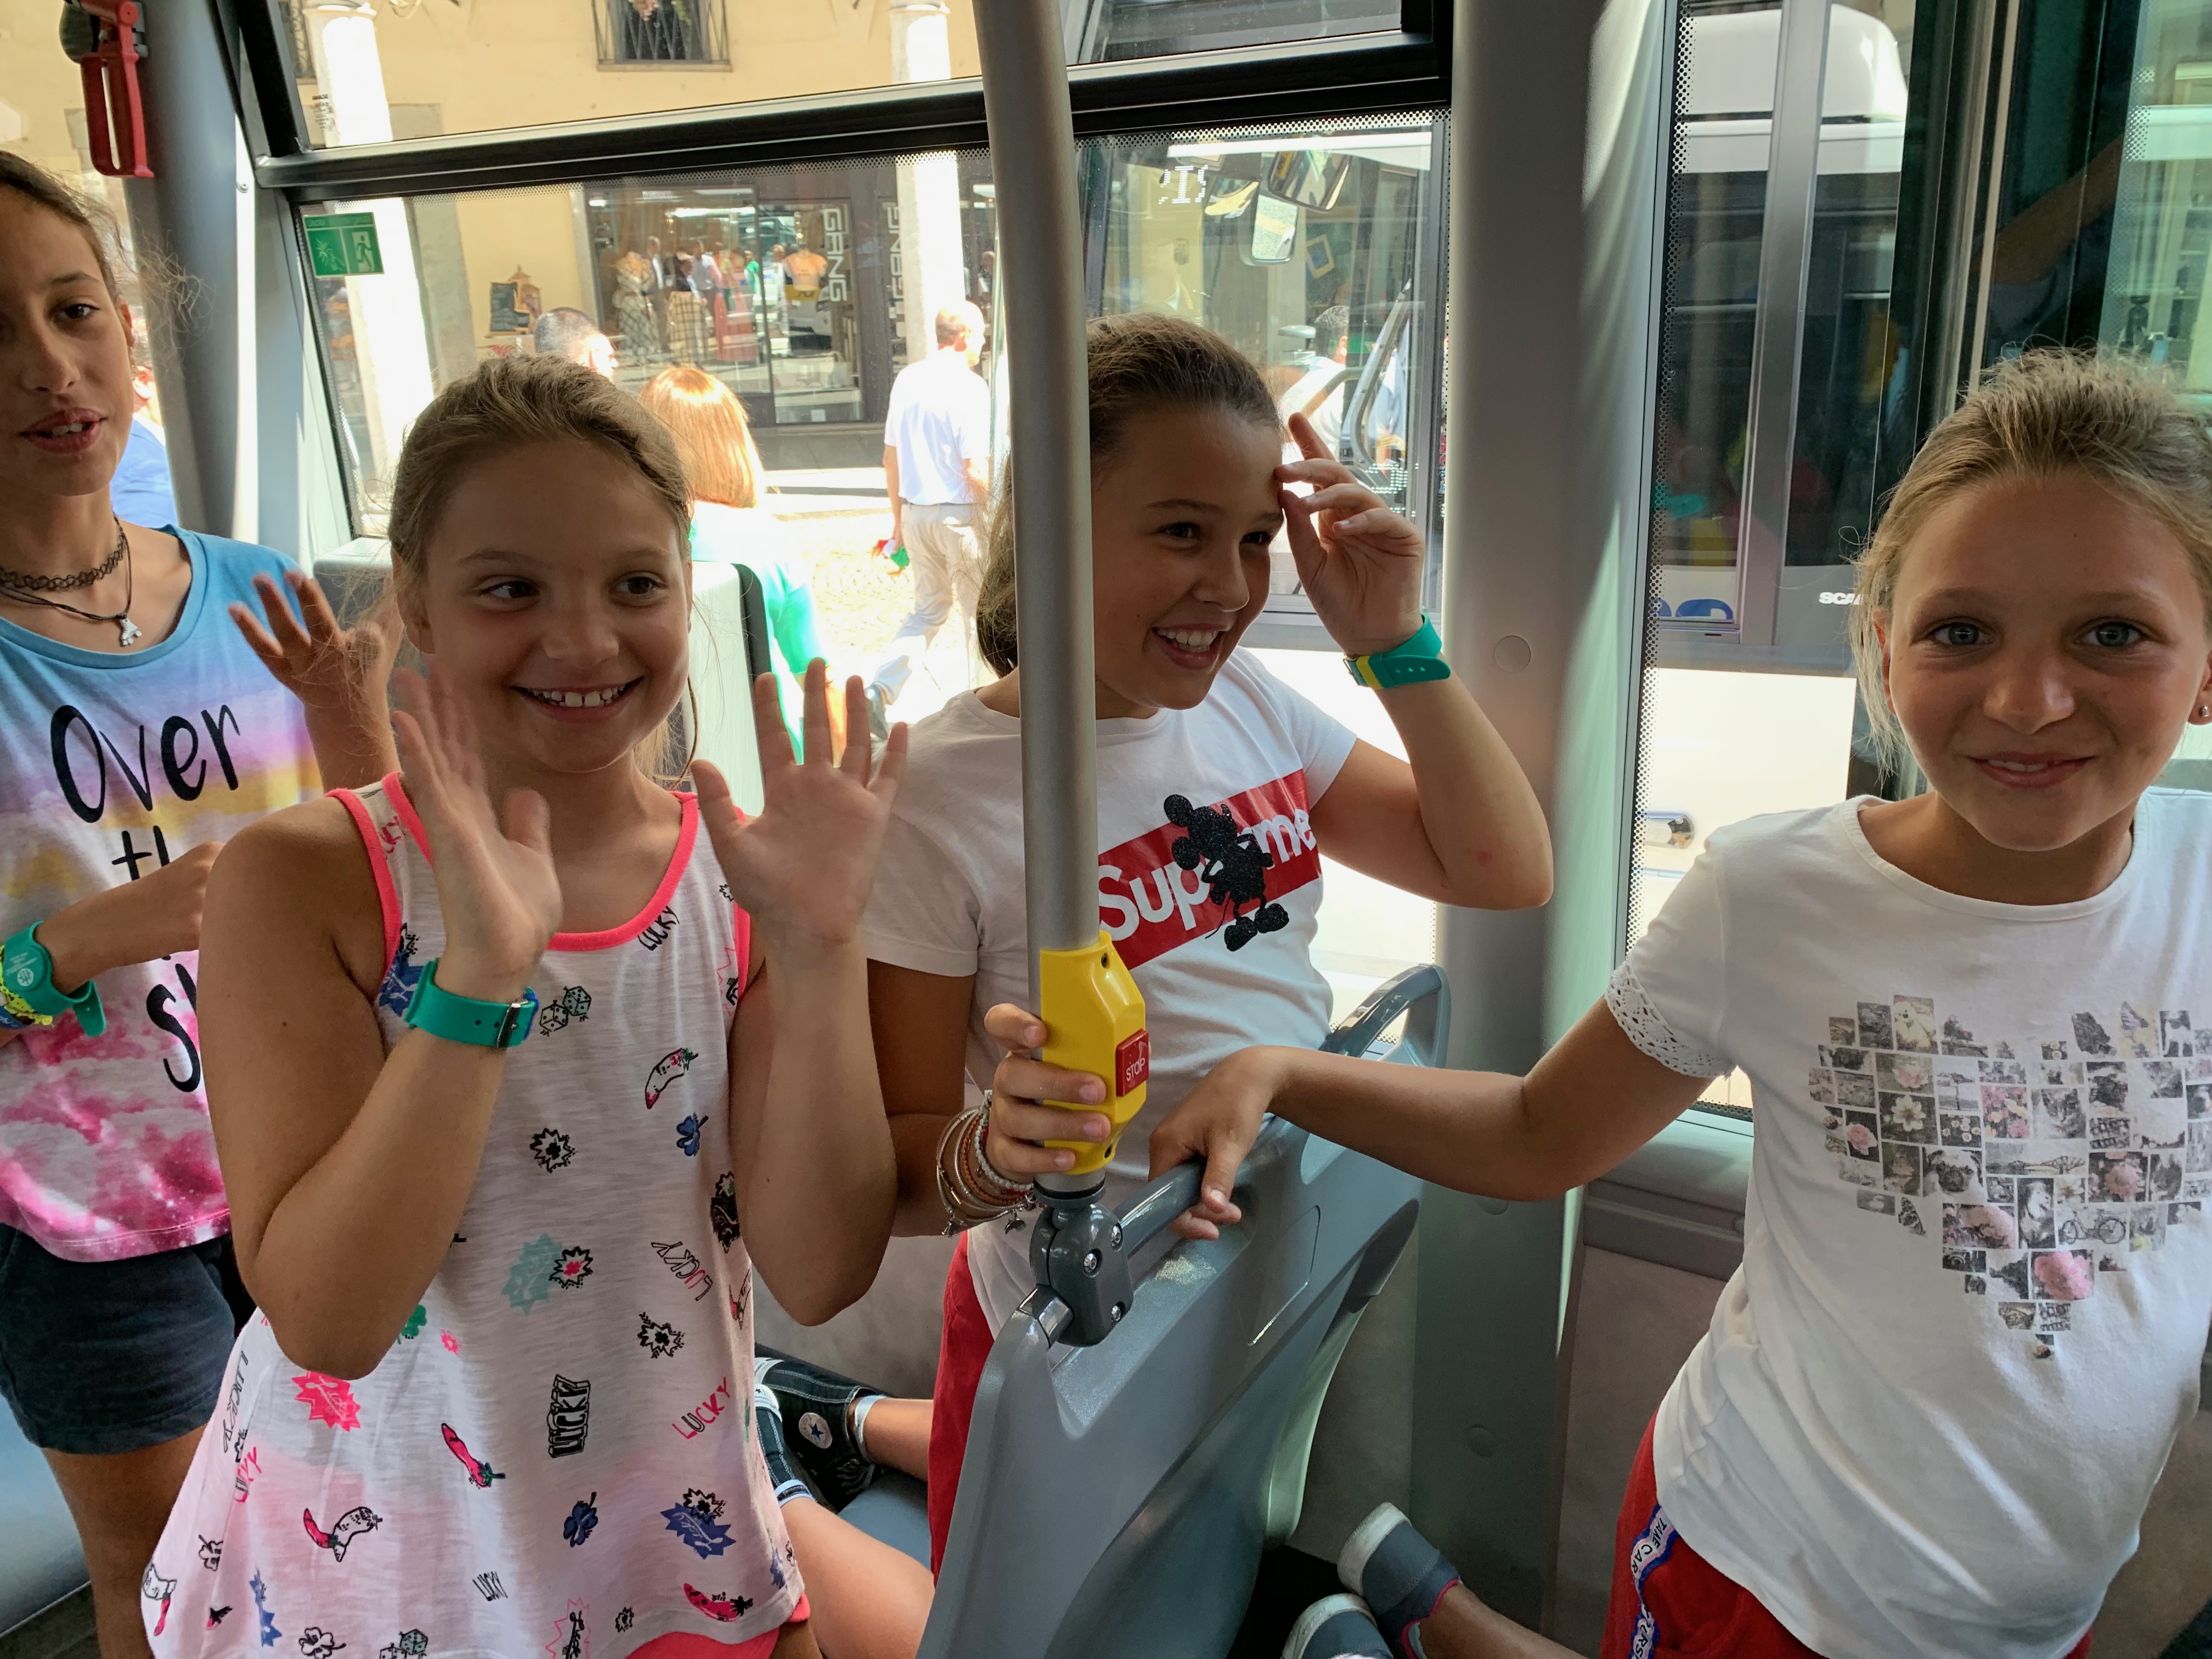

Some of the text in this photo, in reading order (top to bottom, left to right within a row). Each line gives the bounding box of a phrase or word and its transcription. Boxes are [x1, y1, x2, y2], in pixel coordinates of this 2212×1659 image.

[822, 207, 848, 302] GANG
[51, 704, 241, 823] Over
[1098, 808, 1316, 941] Supme
[1126, 1057, 1146, 1082] STOP
[651, 1241, 713, 1301] LUCKY
[546, 1374, 591, 1458] LUCKY
[672, 1376, 731, 1440] LUCKY
[1632, 1544, 1654, 1578] CAR
